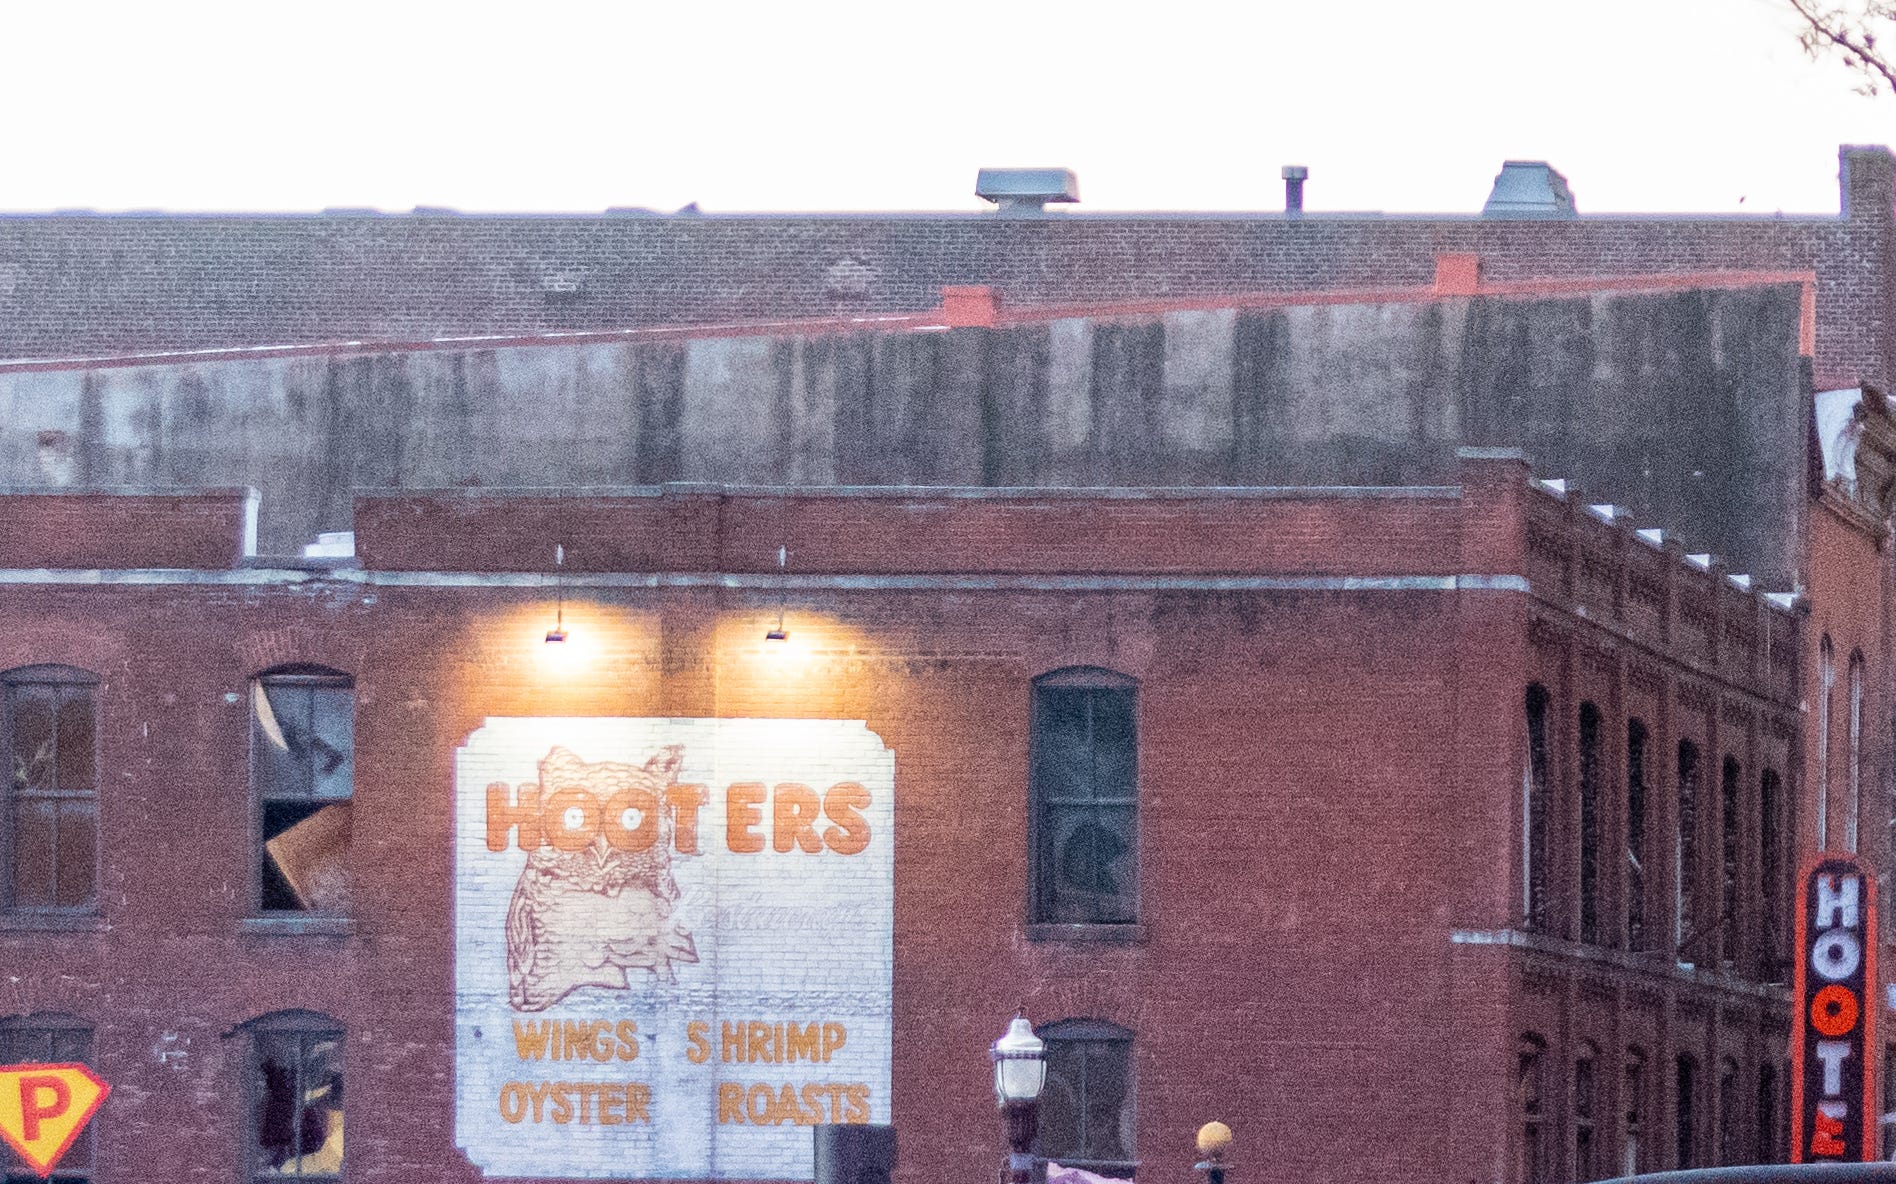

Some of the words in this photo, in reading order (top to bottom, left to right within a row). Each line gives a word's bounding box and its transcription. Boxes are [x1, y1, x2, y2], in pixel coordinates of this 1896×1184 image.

[485, 781, 872, 855] HOOTERS
[512, 1019, 641, 1063] WINGS
[686, 1020, 847, 1064] SHRIMP
[19, 1074, 72, 1141] P
[499, 1081, 652, 1126] OYSTER
[718, 1083, 871, 1126] ROASTS
